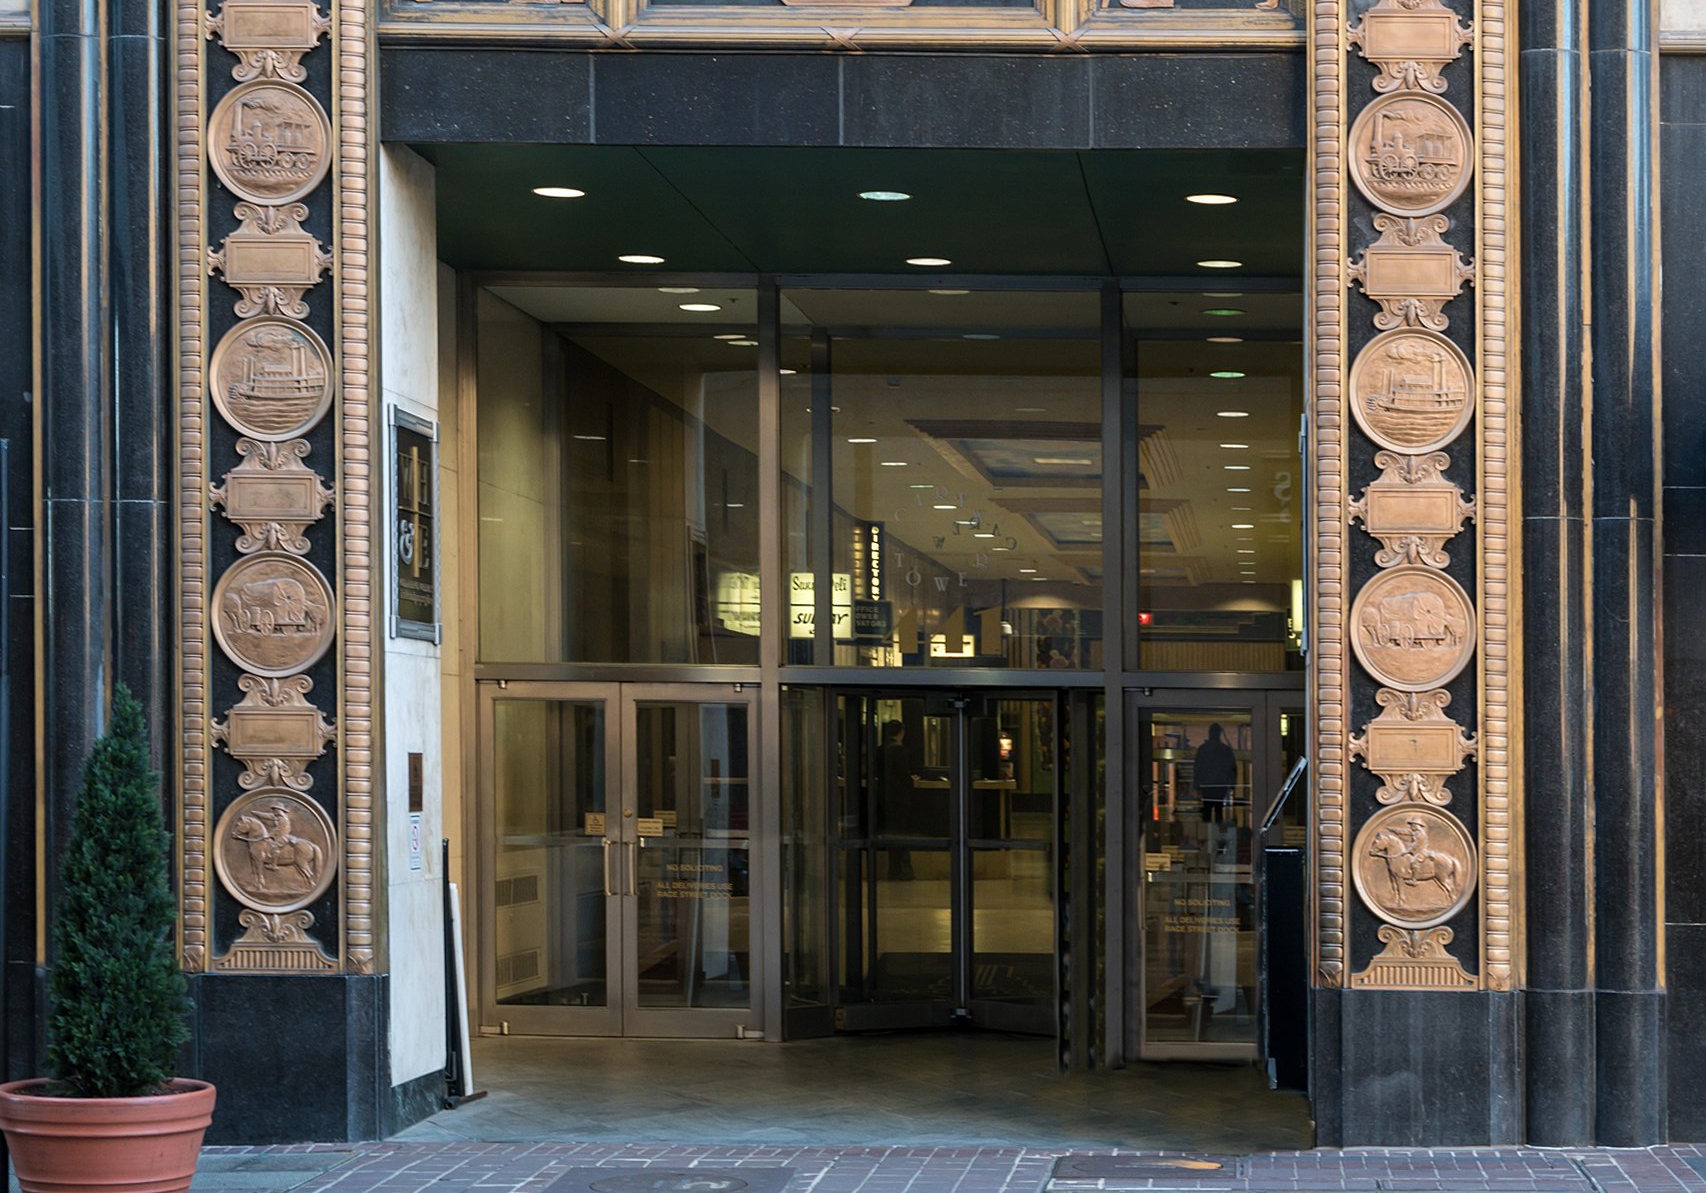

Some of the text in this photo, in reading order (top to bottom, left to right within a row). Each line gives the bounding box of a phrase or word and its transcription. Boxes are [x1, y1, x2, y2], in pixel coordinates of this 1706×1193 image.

[871, 526, 880, 601] DIRECTORY
[895, 552, 989, 591] TOWER
[793, 613, 849, 625] SUAY
[882, 603, 1001, 655] 441
[666, 864, 724, 872] NO SOLICITING
[656, 881, 671, 889] ALL
[672, 882, 717, 890] DELIVERIES
[680, 891, 708, 899] STREET
[1174, 898, 1232, 907] NO SOLICITING
